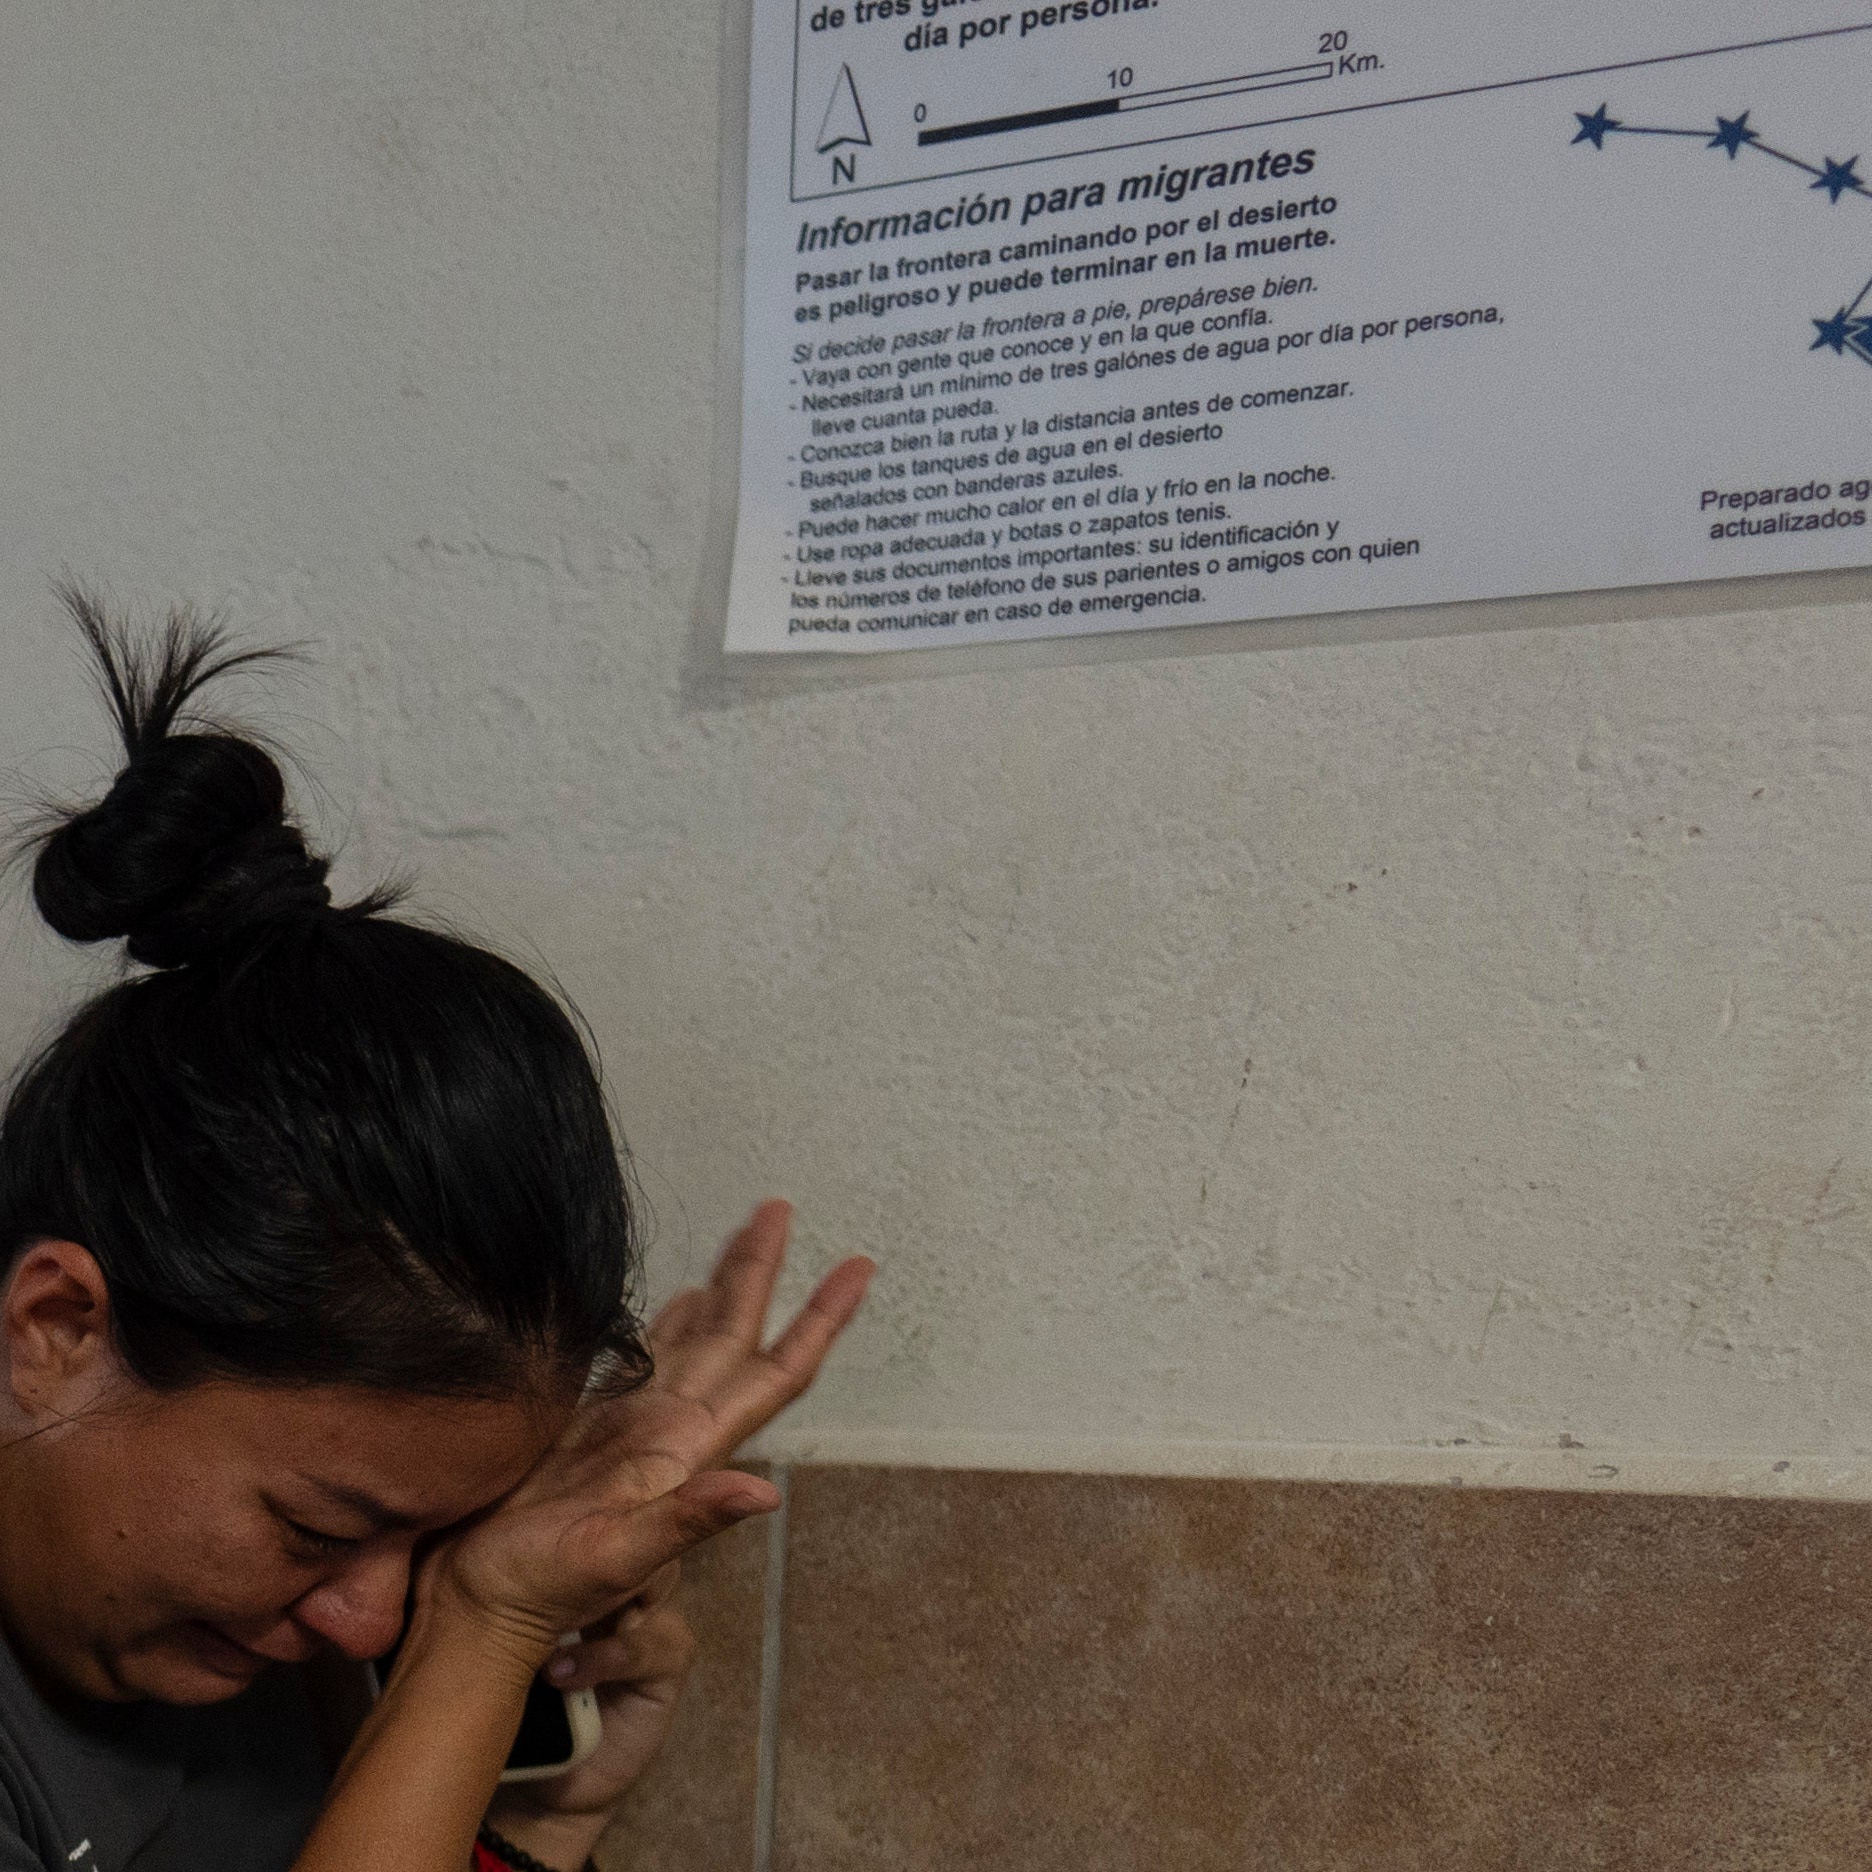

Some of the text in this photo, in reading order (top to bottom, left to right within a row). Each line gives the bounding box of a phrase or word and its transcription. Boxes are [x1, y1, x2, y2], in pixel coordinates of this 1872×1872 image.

[810, 6, 845, 32] de
[904, 22, 949, 51] día
[959, 14, 1012, 49] por
[1318, 30, 1348, 54] 20
[1107, 67, 1133, 89] 10
[1338, 53, 1385, 76] Km.
[914, 103, 926, 123] 0
[832, 153, 855, 185] N
[798, 149, 1315, 252] Información para migrantes
[795, 195, 1338, 293] Pasar la frontera caminando por el desierto
[794, 228, 1335, 323] es peligroso y puede terminar en la muerte.
[818, 335, 886, 360] decide
[891, 327, 953, 355] pasar
[956, 321, 976, 341] la
[982, 311, 1066, 337] frontera
[1071, 307, 1087, 326] a
[1090, 300, 1131, 327] pie,
[1138, 284, 1256, 320] prepárese
[1262, 275, 1318, 299] bien.
[802, 367, 851, 388] Vaya
[856, 361, 893, 380] con
[897, 352, 952, 379] gente
[957, 347, 995, 370] que
[1000, 336, 1075, 360] conoce
[1079, 333, 1093, 355] y
[1097, 329, 1124, 348] en
[1130, 323, 1149, 343] la
[1154, 319, 1195, 343] que
[1201, 307, 1272, 333] confía.
[802, 384, 904, 411] Necesitará
[909, 381, 935, 399] un
[940, 371, 1013, 394] mínimo
[1018, 365, 1045, 385] de
[1050, 360, 1089, 380] tres
[1094, 349, 1177, 379] galónes
[1182, 342, 1210, 363] de
[1215, 336, 1270, 362] agua
[1276, 331, 1314, 355] por
[1318, 323, 1355, 345] día
[1360, 319, 1399, 344] por
[1404, 307, 1504, 338] persona,
[800, 440, 885, 462] Conozca
[890, 434, 932, 452] bien
[937, 428, 955, 447] la
[960, 424, 999, 444] ruta
[1004, 424, 1017, 444] y
[1021, 418, 1040, 437] la
[1045, 406, 1136, 433] distancia
[1142, 400, 1200, 422] antes
[1206, 393, 1235, 414] de
[1240, 381, 1353, 409] comenzar.
[811, 398, 998, 437] lleve cuanta pueda.
[800, 467, 873, 490] Busque
[878, 462, 906, 480] los
[911, 453, 990, 476] tanques
[994, 446, 1021, 466] de
[1025, 442, 1076, 466] agua
[1081, 437, 1108, 456] en
[1113, 431, 1133, 452] el
[1138, 423, 1223, 449] desierto
[797, 517, 860, 538] Puede
[865, 512, 920, 531] hacer
[925, 503, 992, 525] mucho
[996, 496, 1046, 518] calor
[1051, 494, 1077, 512] en
[1082, 488, 1101, 508] el
[1106, 485, 1139, 506] día
[1145, 485, 1159, 506] y
[1163, 478, 1199, 499] frío
[1203, 477, 1232, 495] en
[1237, 471, 1257, 491] la
[1263, 465, 1335, 488] noche.
[810, 462, 1123, 512] señalados con banderas azules.
[1700, 479, 1872, 512] Preparado ag
[796, 545, 836, 564] Use
[840, 541, 884, 562] ropa
[889, 529, 986, 555] adecuada
[991, 529, 1004, 550] y
[1008, 522, 1064, 543] botas
[1068, 520, 1083, 536] o
[1088, 510, 1169, 535] zapatos
[1175, 502, 1231, 525] tenis.
[1710, 507, 1866, 540] actualizados
[790, 538, 1421, 610] los números de teléfono de sus parientes o amigos con quien
[794, 570, 848, 587] Lleve
[852, 566, 887, 584] sus
[892, 554, 1012, 580] documentos
[1017, 541, 1140, 568] importantes:
[1148, 537, 1174, 555] su
[1180, 520, 1320, 550] identificación
[1326, 520, 1340, 542] y
[788, 586, 1205, 636] pueda comunicar en caso de emergencia.
